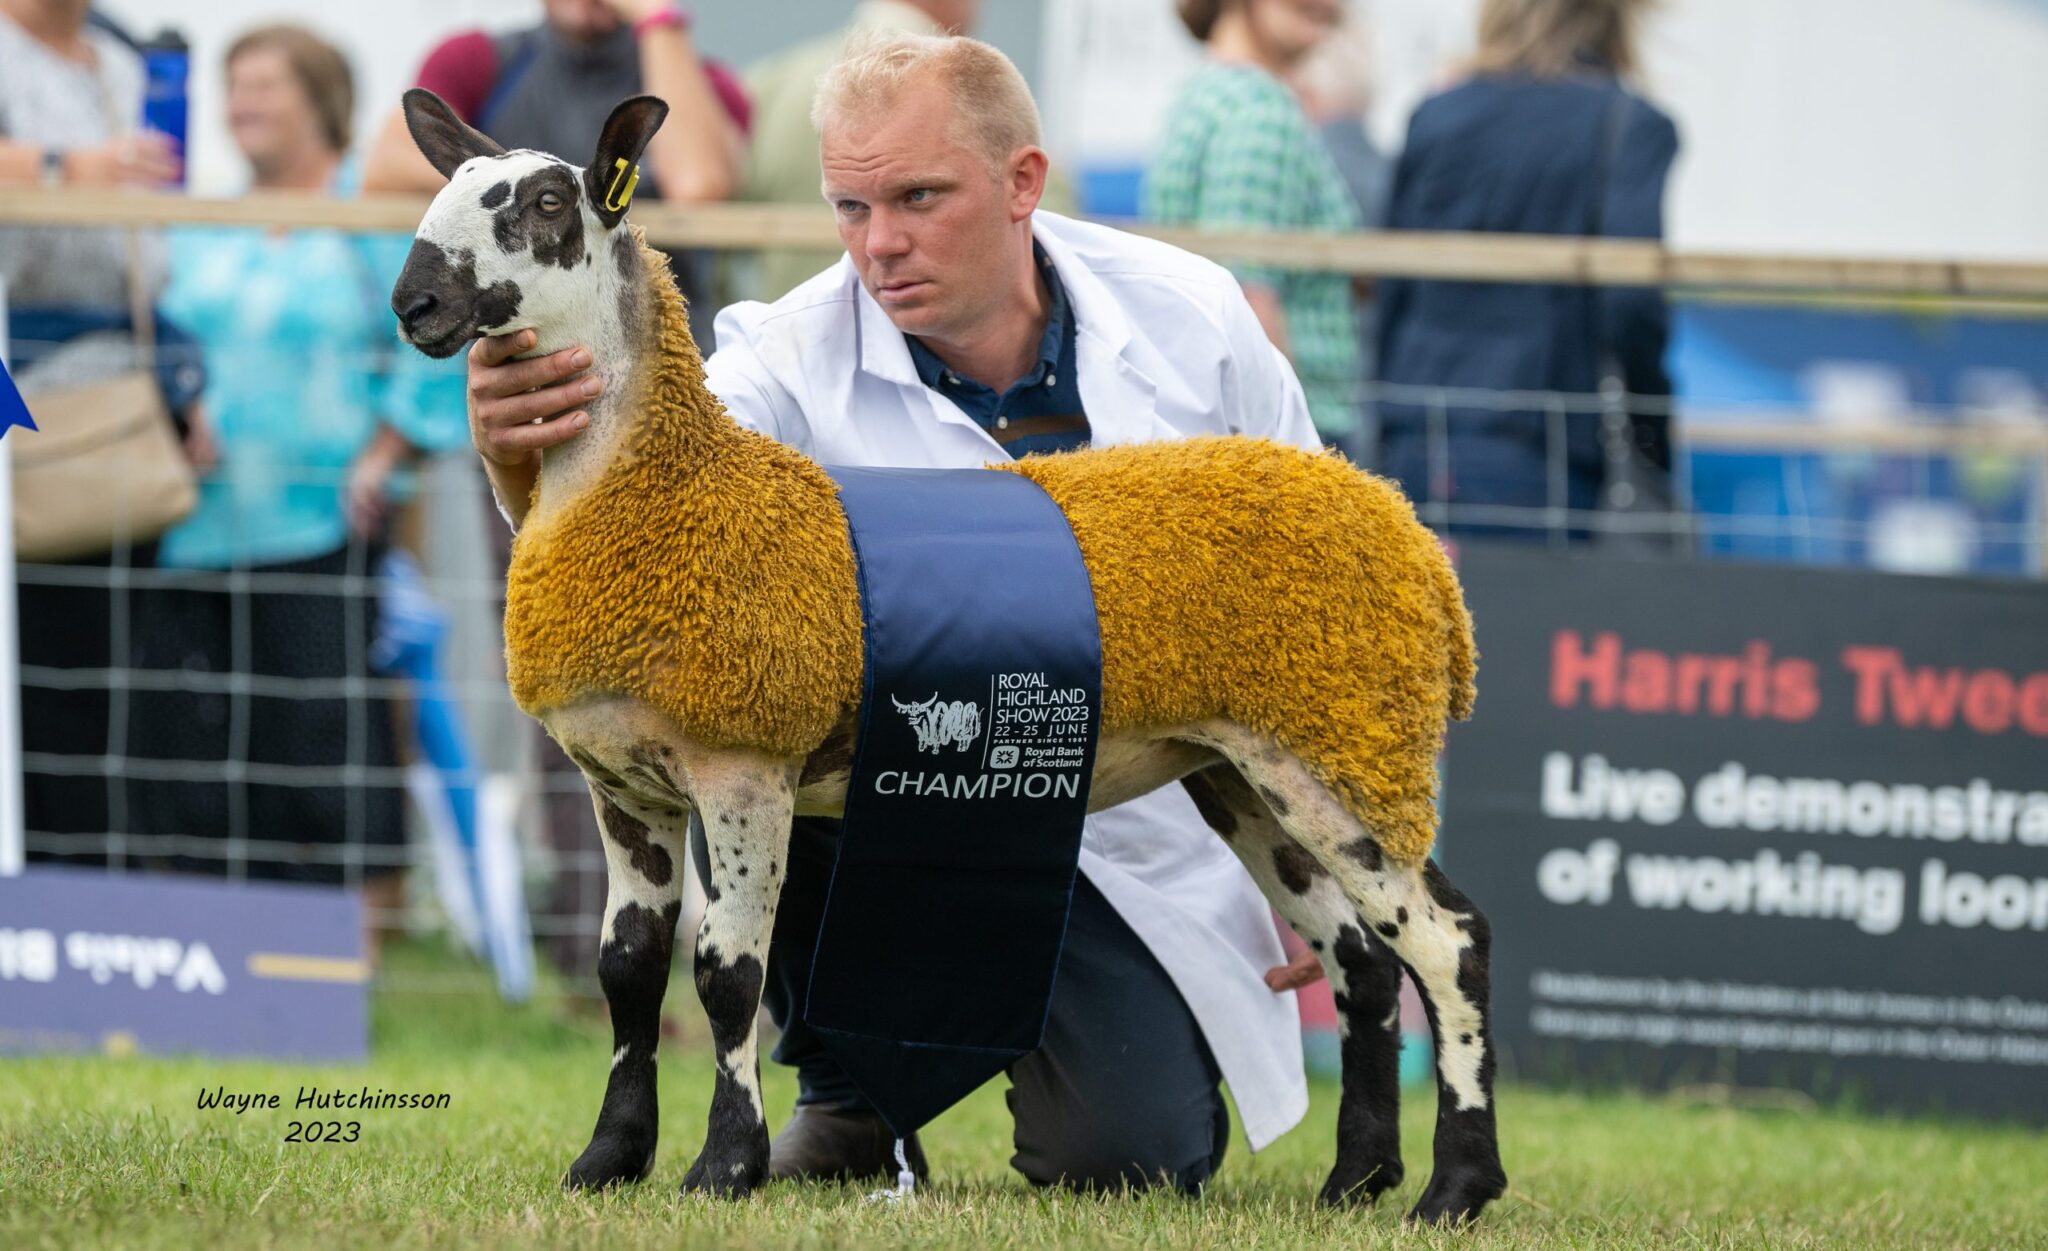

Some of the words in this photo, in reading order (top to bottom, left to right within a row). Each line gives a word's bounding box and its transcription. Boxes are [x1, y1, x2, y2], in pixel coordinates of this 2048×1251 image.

[998, 672, 1049, 689] ROYAL
[1548, 628, 1822, 722] Harris
[998, 688, 1086, 707] HIGHLAND
[994, 726, 1009, 737] 22
[1023, 725, 1039, 736] 25
[1047, 723, 1088, 737] JUNE
[1025, 746, 1056, 759] Royal
[1057, 746, 1085, 756] Bank
[1023, 757, 1037, 768] of
[1037, 757, 1083, 768] Scotland
[875, 771, 1081, 799] CHAMPION
[1539, 749, 1686, 826] Live
[1535, 838, 1622, 905] of
[1626, 846, 1906, 935] working
[1918, 857, 2048, 932] loo
